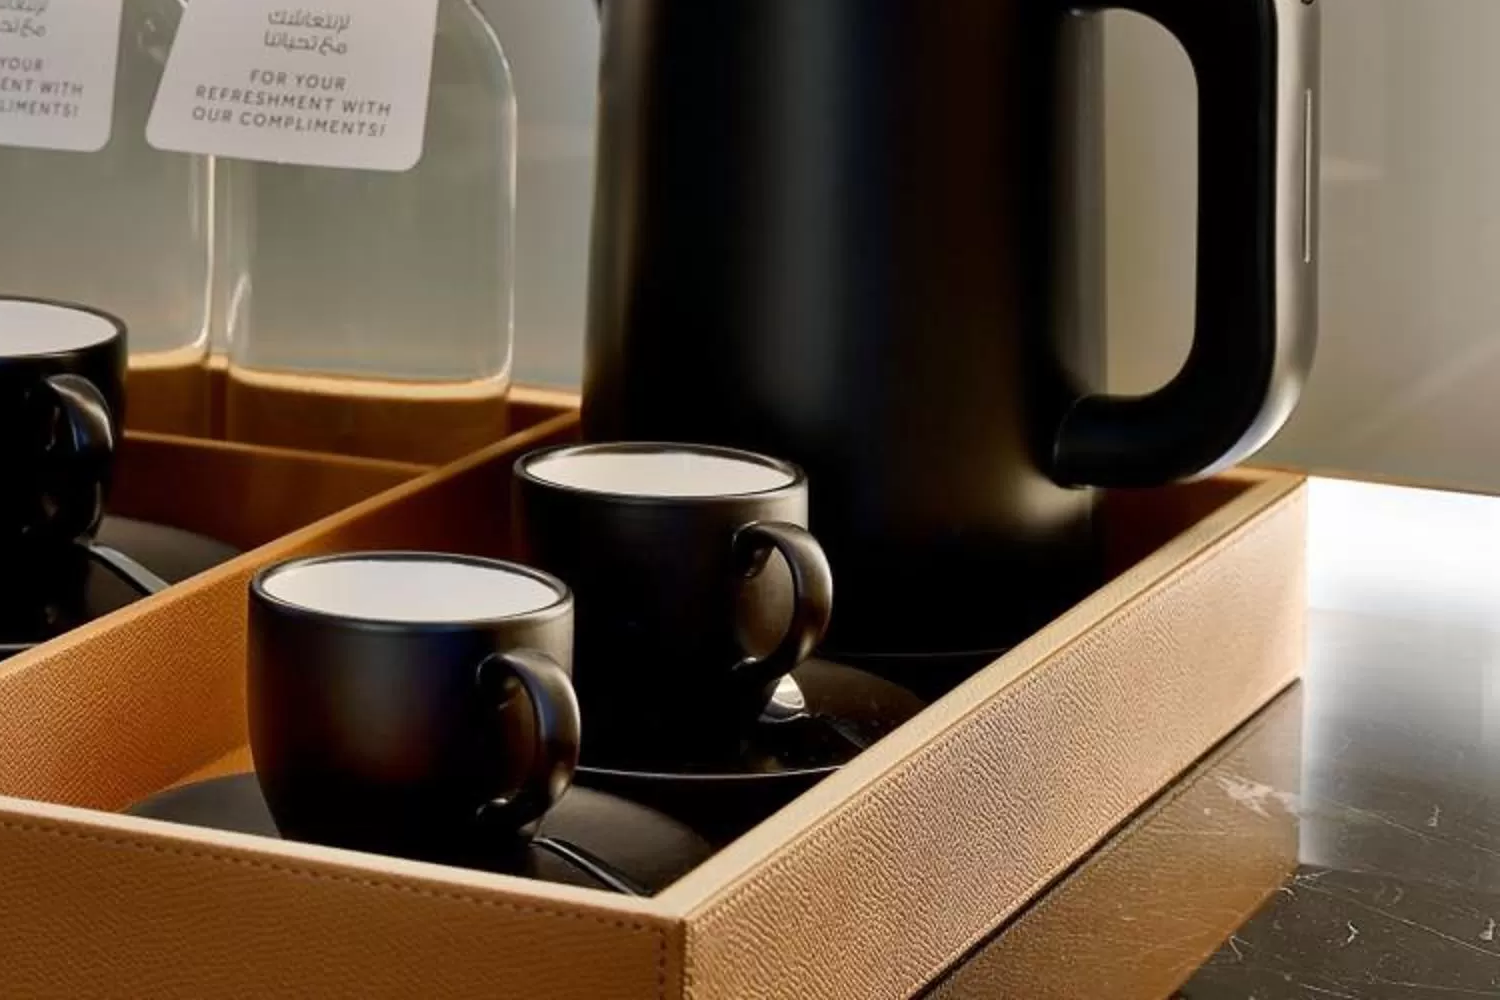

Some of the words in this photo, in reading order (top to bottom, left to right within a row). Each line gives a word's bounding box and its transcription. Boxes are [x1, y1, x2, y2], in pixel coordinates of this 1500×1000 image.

[40, 80, 84, 99] WITH
[250, 69, 287, 86] FOR
[296, 73, 347, 92] YOUR
[195, 83, 335, 113] REFRESHMENT
[342, 99, 392, 117] WITH
[191, 105, 233, 123] OUR
[239, 111, 387, 138] COMPLIMENTS!
